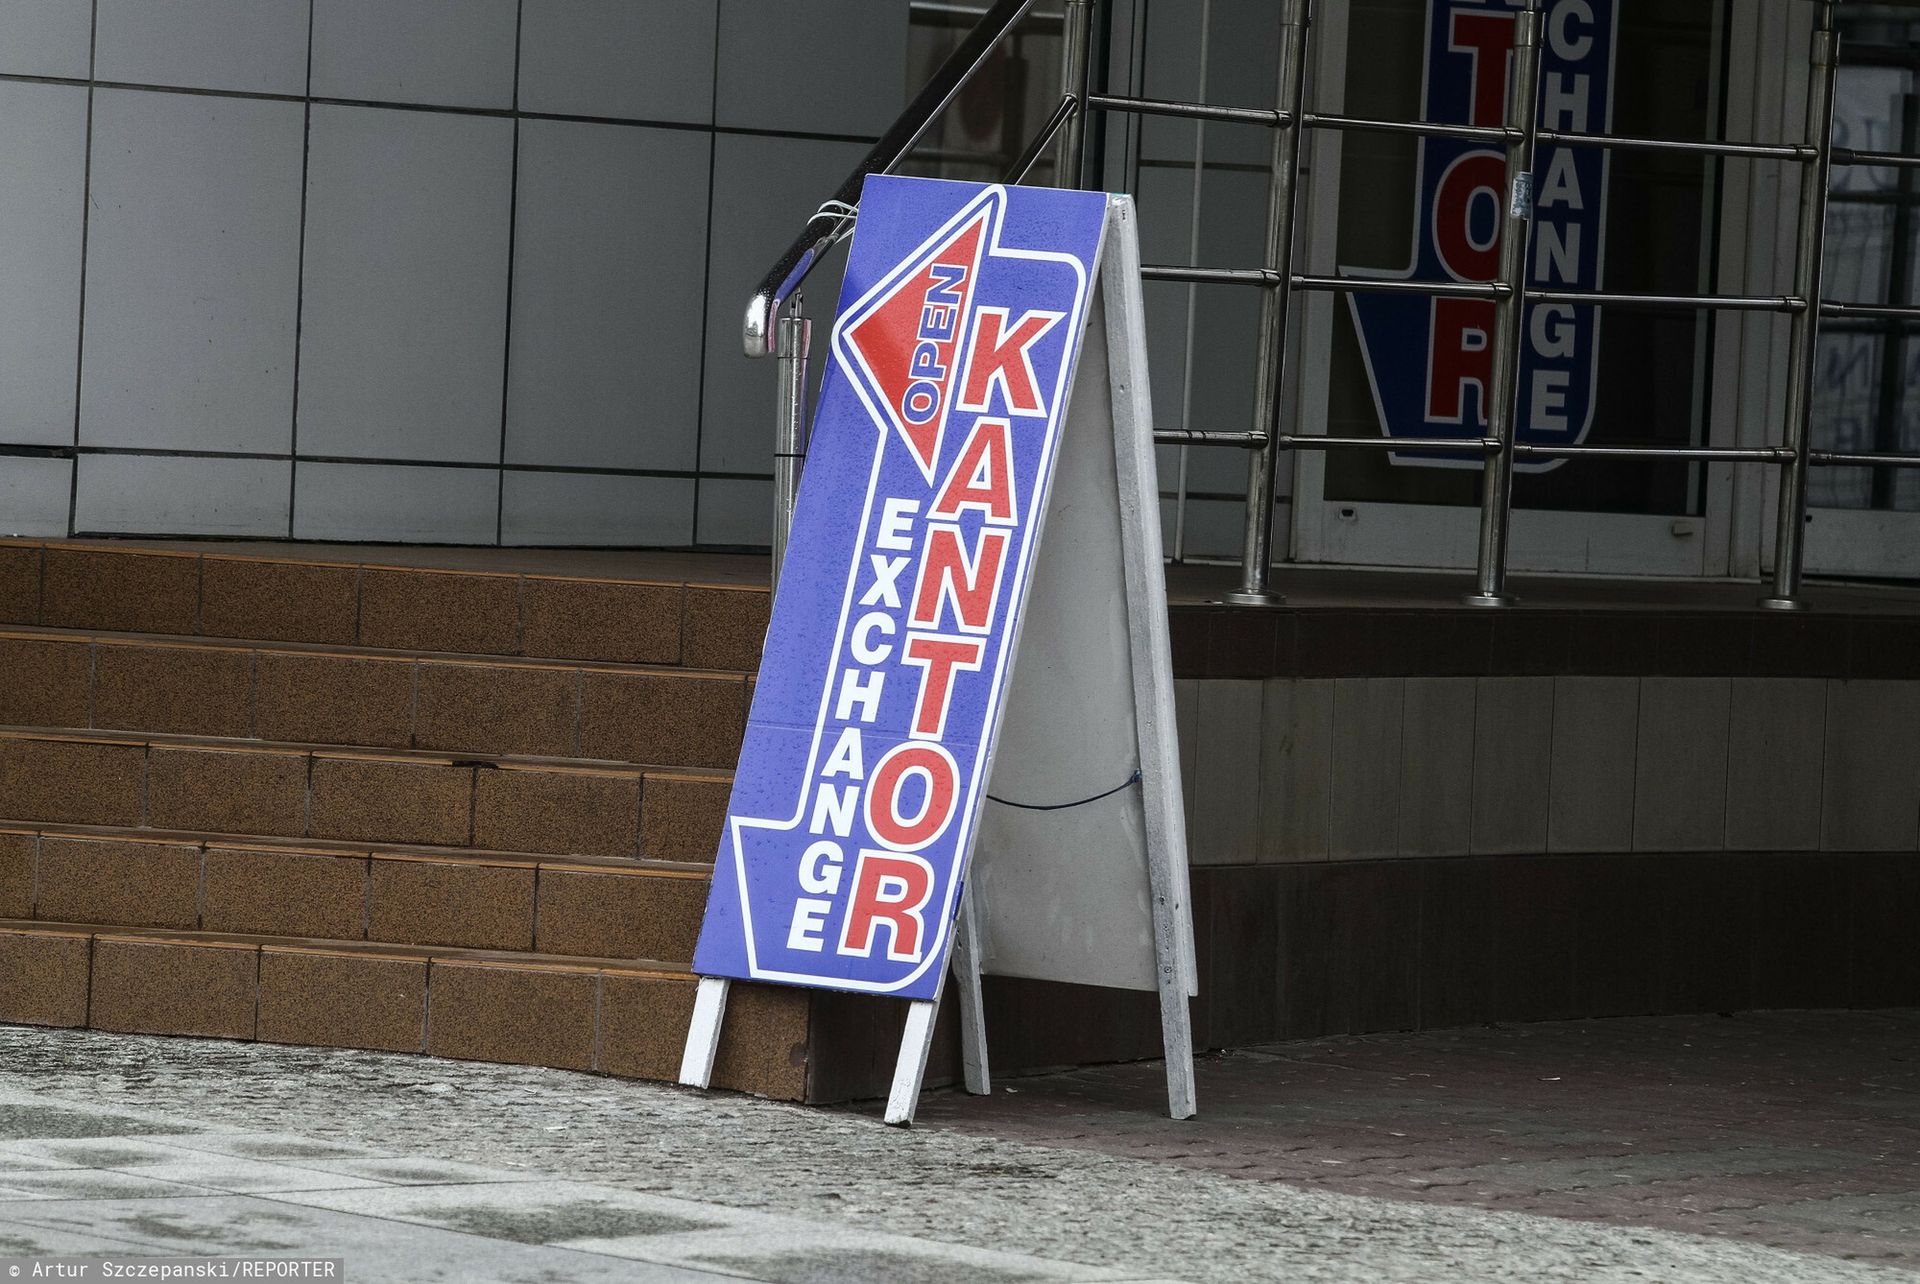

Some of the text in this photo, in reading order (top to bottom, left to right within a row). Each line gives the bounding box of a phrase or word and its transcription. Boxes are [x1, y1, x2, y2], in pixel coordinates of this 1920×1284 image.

[901, 263, 970, 425] OPEN
[786, 497, 920, 953] EXCHANGE
[836, 306, 1067, 964] KANTOR
